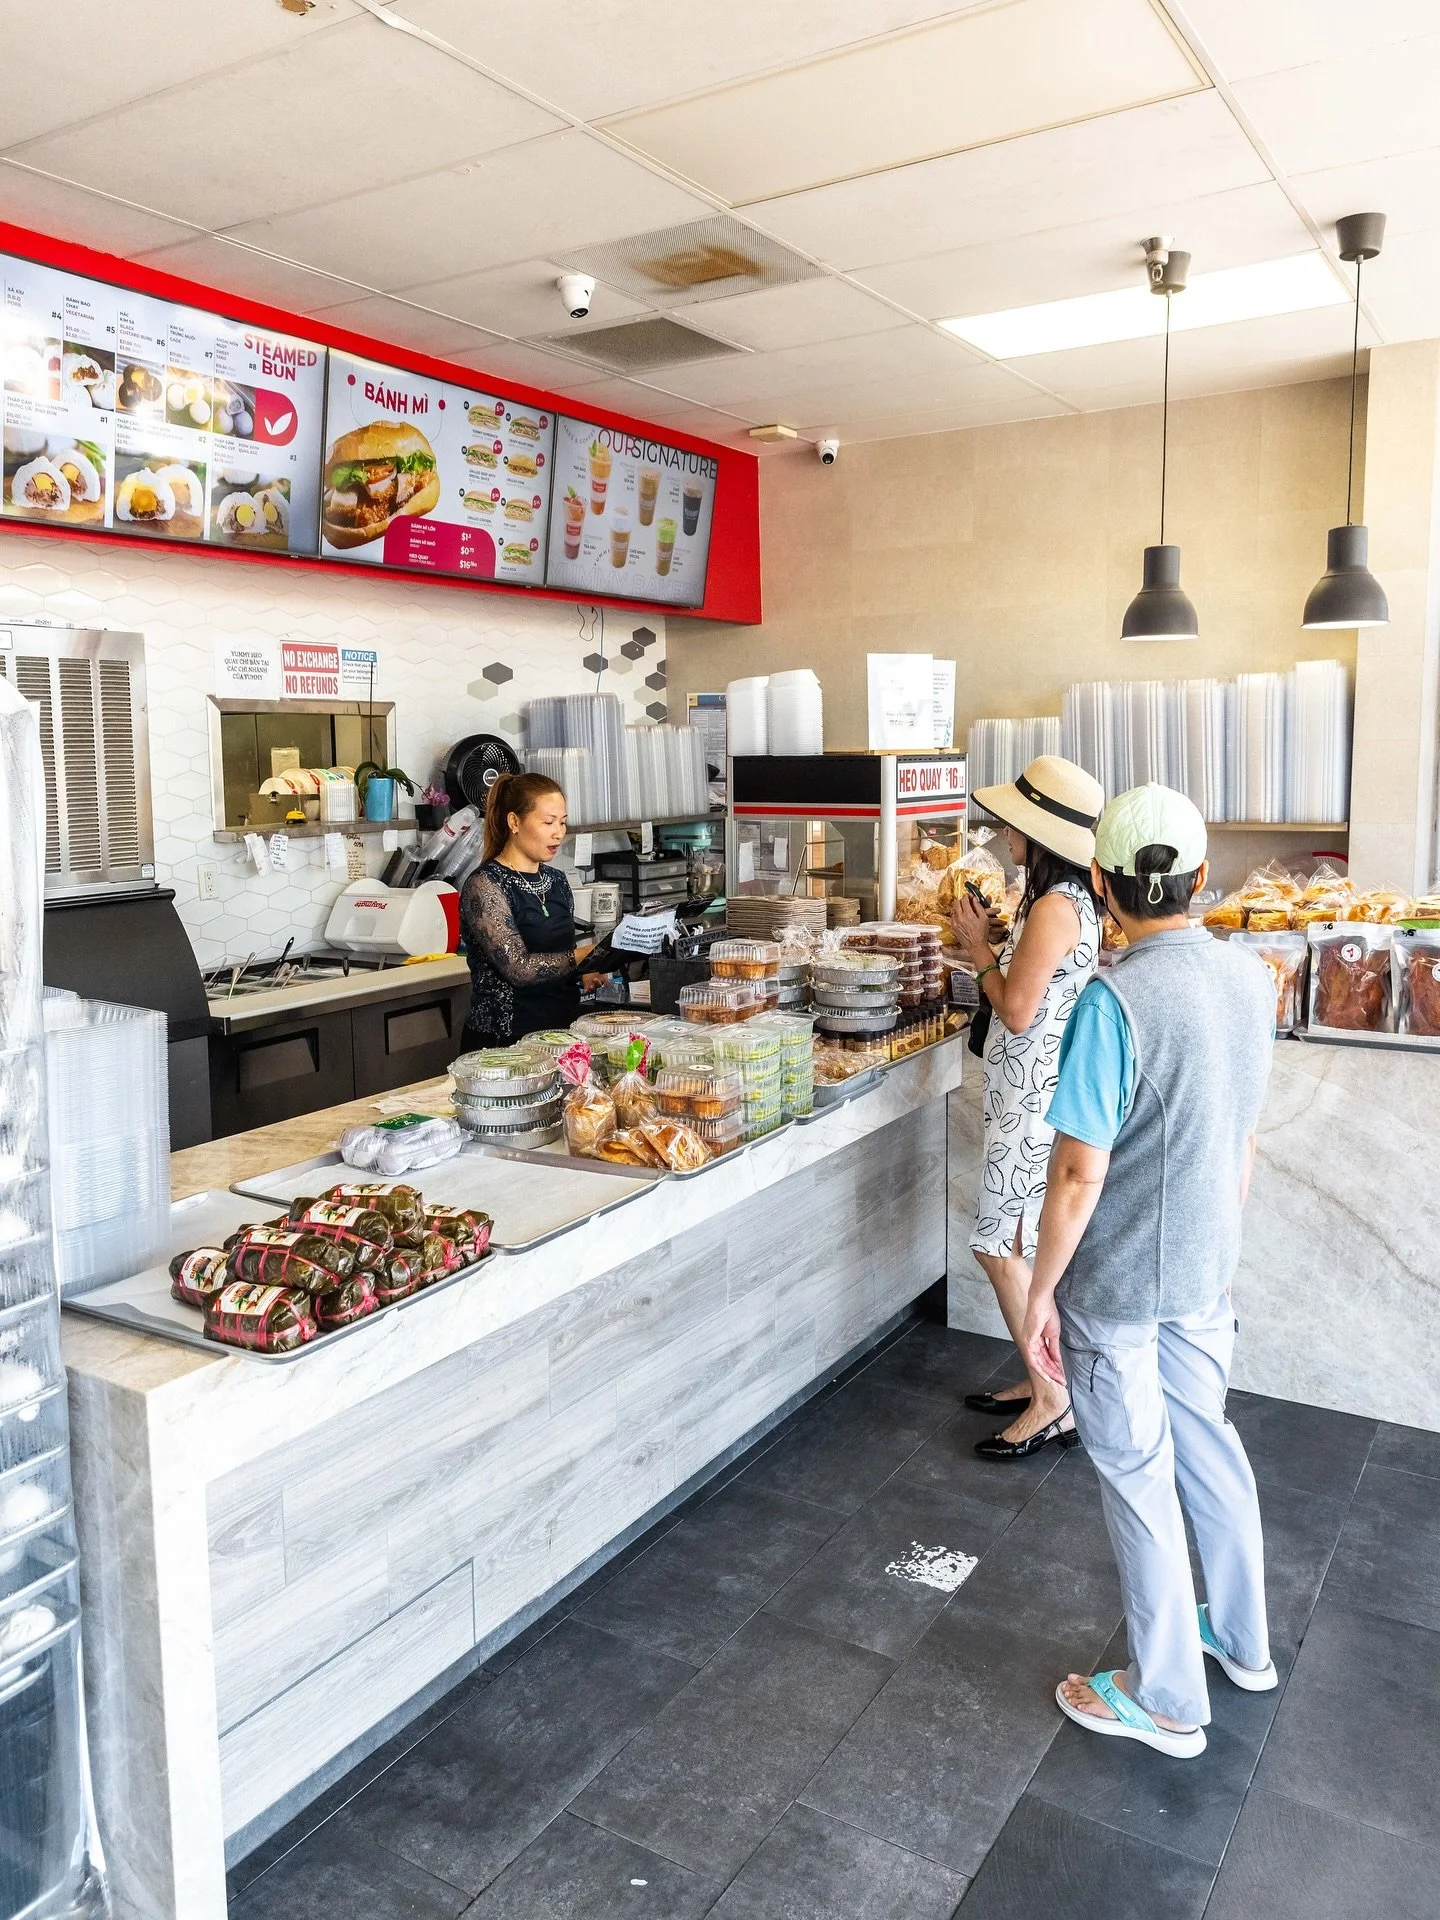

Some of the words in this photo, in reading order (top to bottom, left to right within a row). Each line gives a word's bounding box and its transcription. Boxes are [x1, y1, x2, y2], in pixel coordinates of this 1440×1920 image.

[52, 311, 63, 321] #4
[106, 326, 116, 334] #5
[156, 339, 166, 347] #6
[244, 332, 317, 367] STEAMED
[205, 351, 214, 360] #7
[248, 363, 257, 371] #8
[262, 359, 296, 382] BUN
[364, 382, 408, 414] BÁNH
[412, 394, 429, 414] MÌ
[100, 416, 108, 424] #1
[231, 650, 251, 658] YUMMY
[345, 651, 374, 661] NOTICE
[283, 650, 296, 668] NO
[297, 650, 339, 669] EXCHANGE
[285, 675, 298, 694] NO
[300, 675, 339, 695] REFUNDS
[899, 768, 918, 793] HEO
[920, 768, 942, 792] QUAY
[945, 767, 958, 790] $16
[354, 900, 388, 910] Playmate
[1322, 922, 1334, 931] 36
